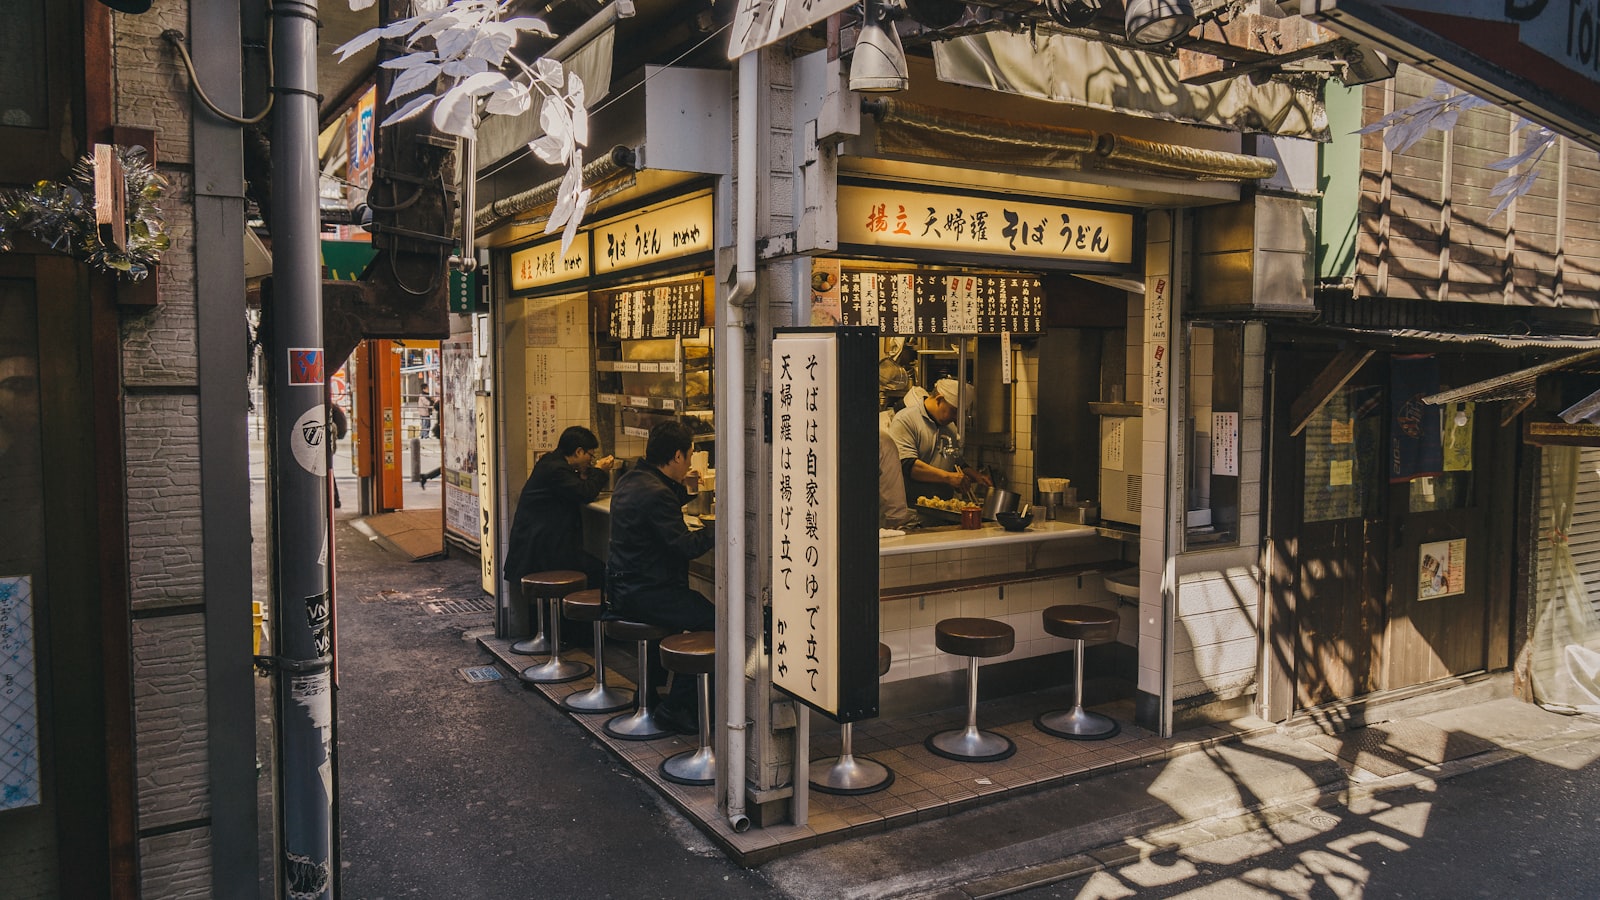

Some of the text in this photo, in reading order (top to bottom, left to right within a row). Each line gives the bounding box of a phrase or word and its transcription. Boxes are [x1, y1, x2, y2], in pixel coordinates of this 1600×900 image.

[865, 203, 1109, 253] 揚立 天婦羅 そば うどん
[607, 224, 701, 267] そば うどん かめや
[916, 276, 924, 305] 大もり
[929, 276, 936, 303] ざる
[987, 278, 996, 303] わかめ
[1022, 279, 1030, 304] たぬき
[1033, 279, 1041, 304] かけ
[777, 354, 793, 678] 天婦羅は揚げ立て かめや
[805, 354, 820, 692] そばは自家製のゆで立て
